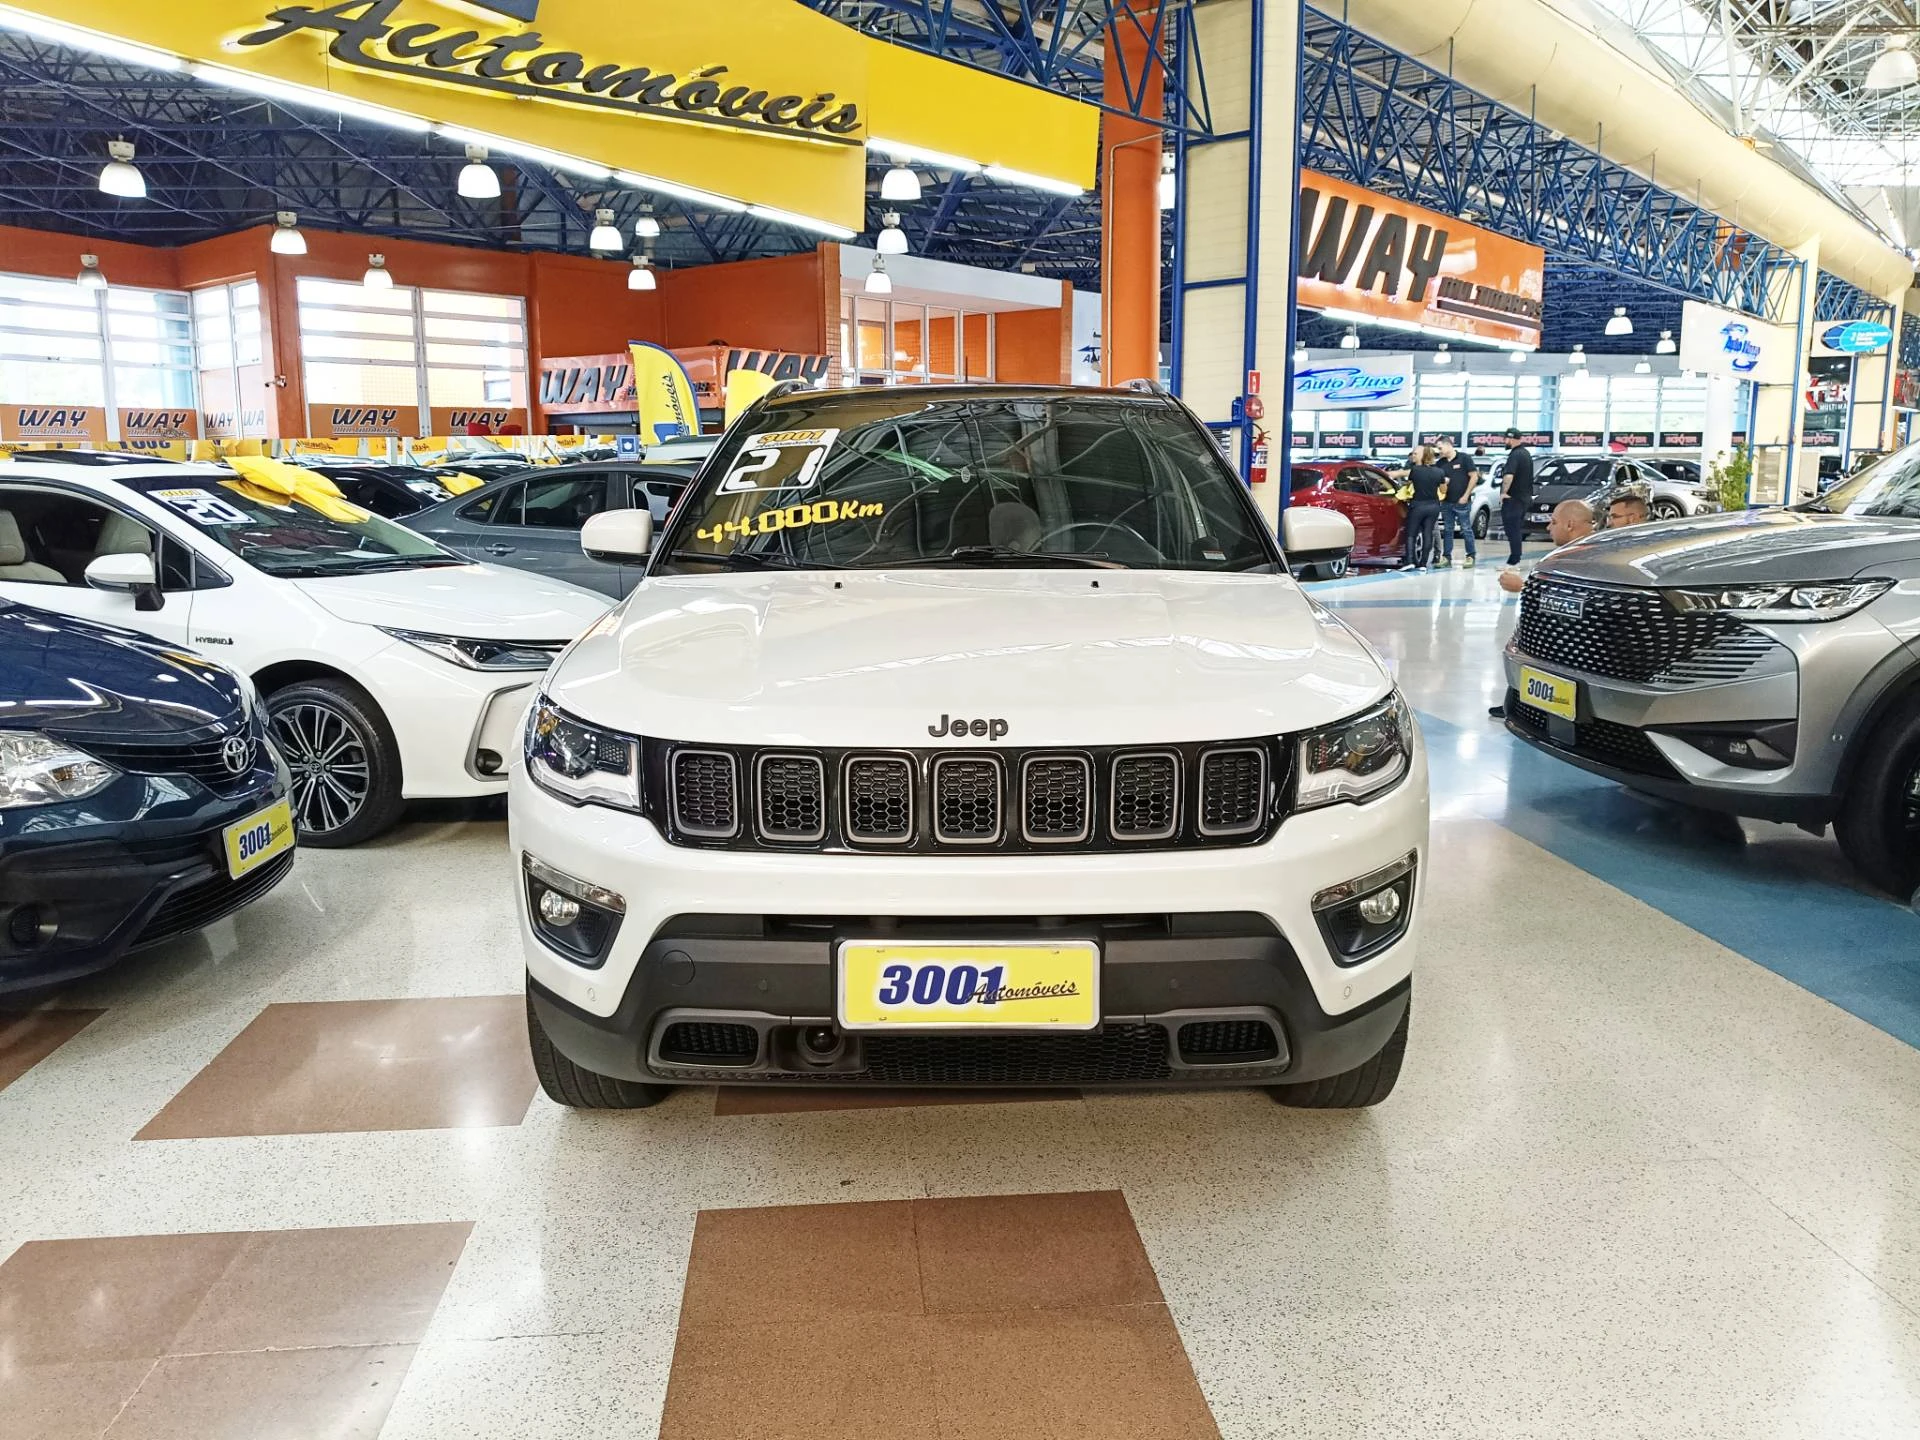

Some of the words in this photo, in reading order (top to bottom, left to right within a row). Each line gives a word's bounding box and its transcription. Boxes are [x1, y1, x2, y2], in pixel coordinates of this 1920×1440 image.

[237, 0, 864, 138] Automóveis
[1298, 187, 1448, 302] WAY
[540, 365, 628, 403] WAY
[1297, 378, 1344, 390] Auto
[1348, 376, 1404, 387] Fluxo
[18, 408, 87, 426] WAY
[127, 411, 187, 428] WAY
[205, 413, 234, 427] WAY
[333, 408, 396, 425] WAY
[451, 411, 507, 427] WAY
[724, 446, 824, 490] 21
[195, 637, 228, 645] HYBRID
[1527, 678, 1555, 702] 3001
[928, 714, 1009, 741] Jeep
[239, 822, 271, 860] 3001
[878, 965, 1003, 1005] 3001
[967, 980, 1080, 1004] Automóveis
